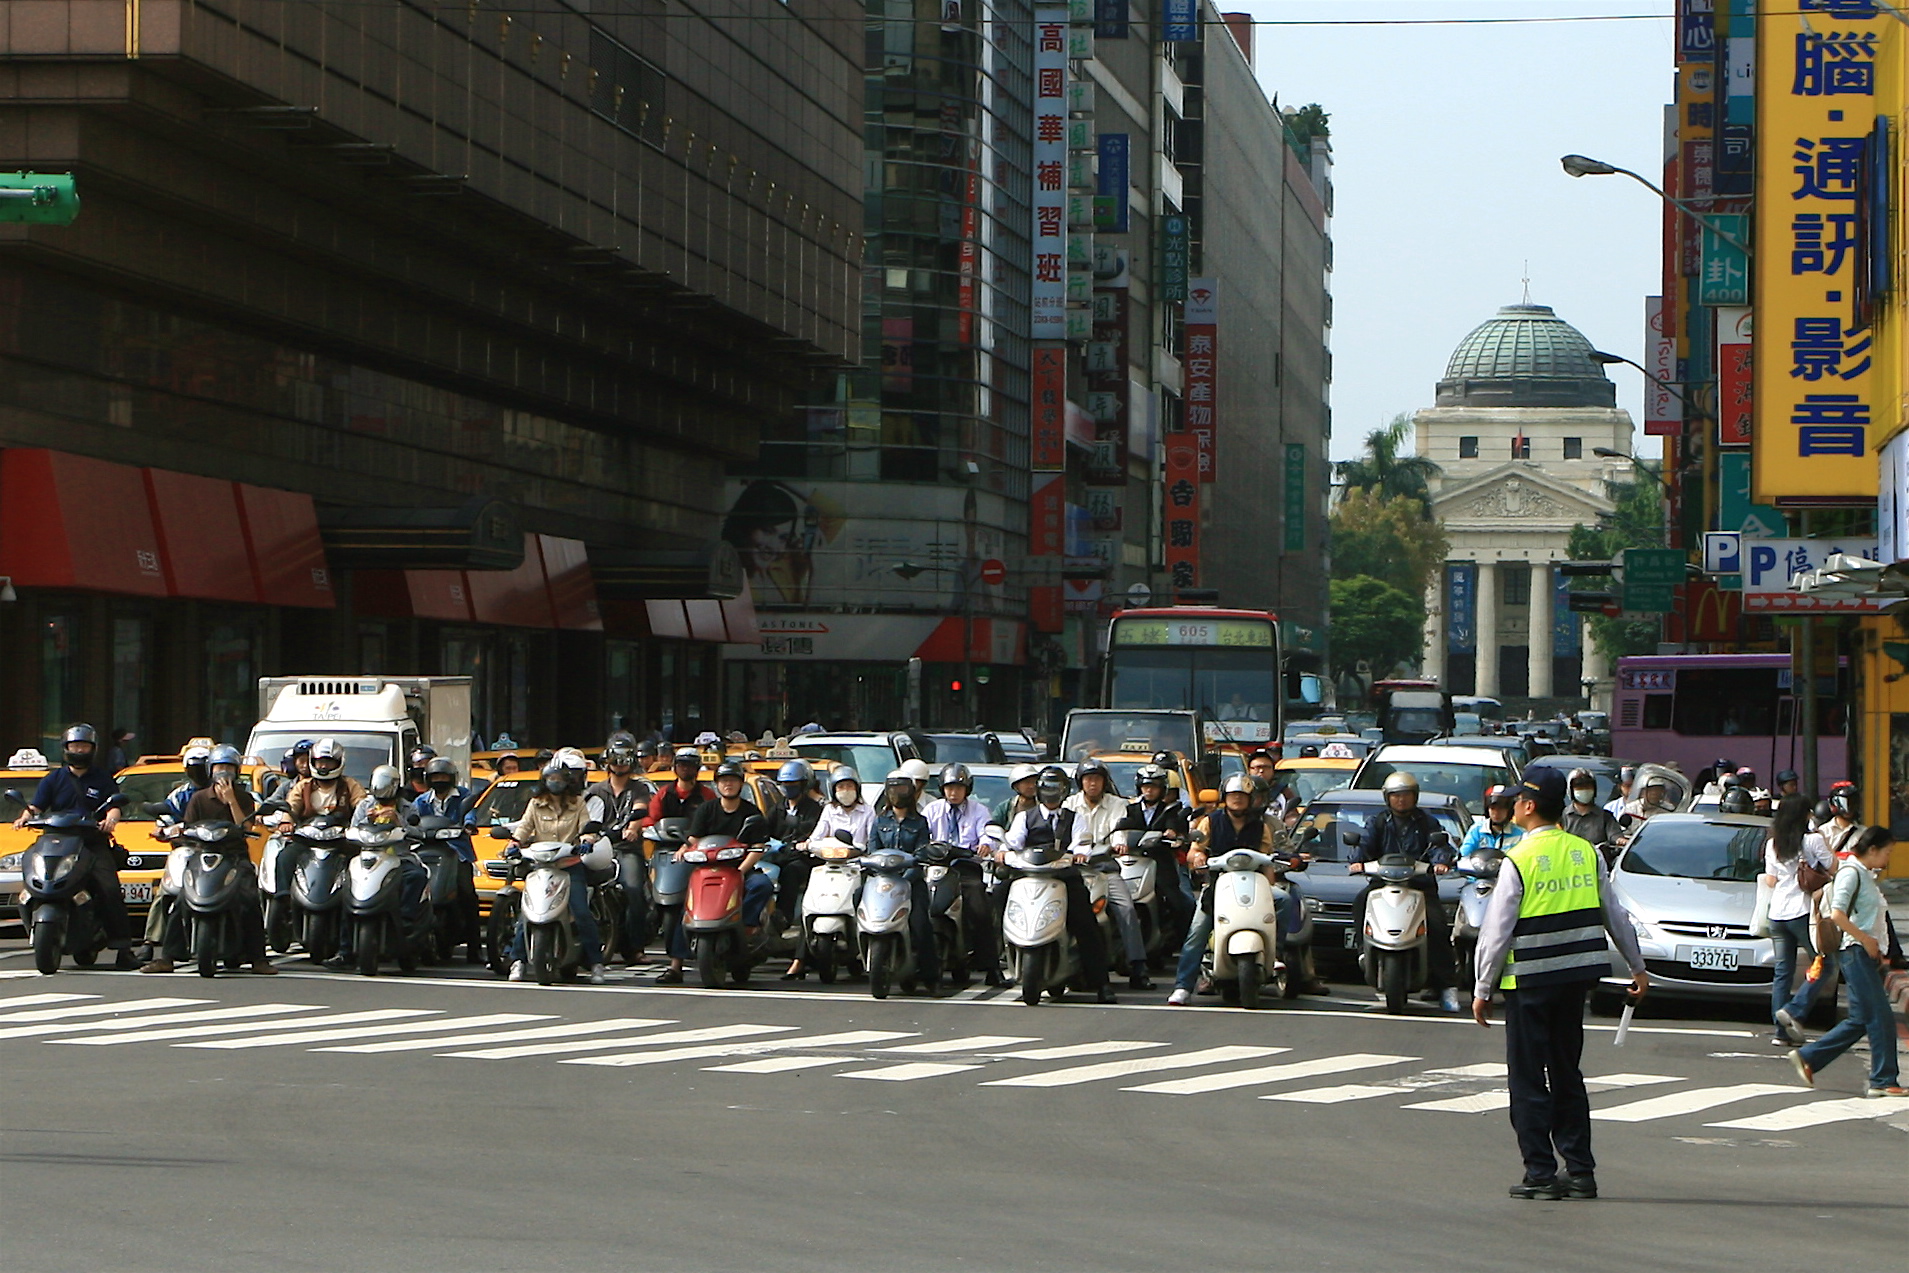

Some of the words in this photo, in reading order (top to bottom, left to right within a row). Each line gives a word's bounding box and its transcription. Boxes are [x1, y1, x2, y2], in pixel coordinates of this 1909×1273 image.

[1036, 23, 1065, 284] 高國華補習班
[1705, 289, 1743, 302] 400
[1707, 535, 1739, 570] P
[1751, 546, 1777, 586] P
[761, 620, 813, 629] ASTONE
[1179, 625, 1208, 637] 605
[1535, 874, 1594, 895] POLICE
